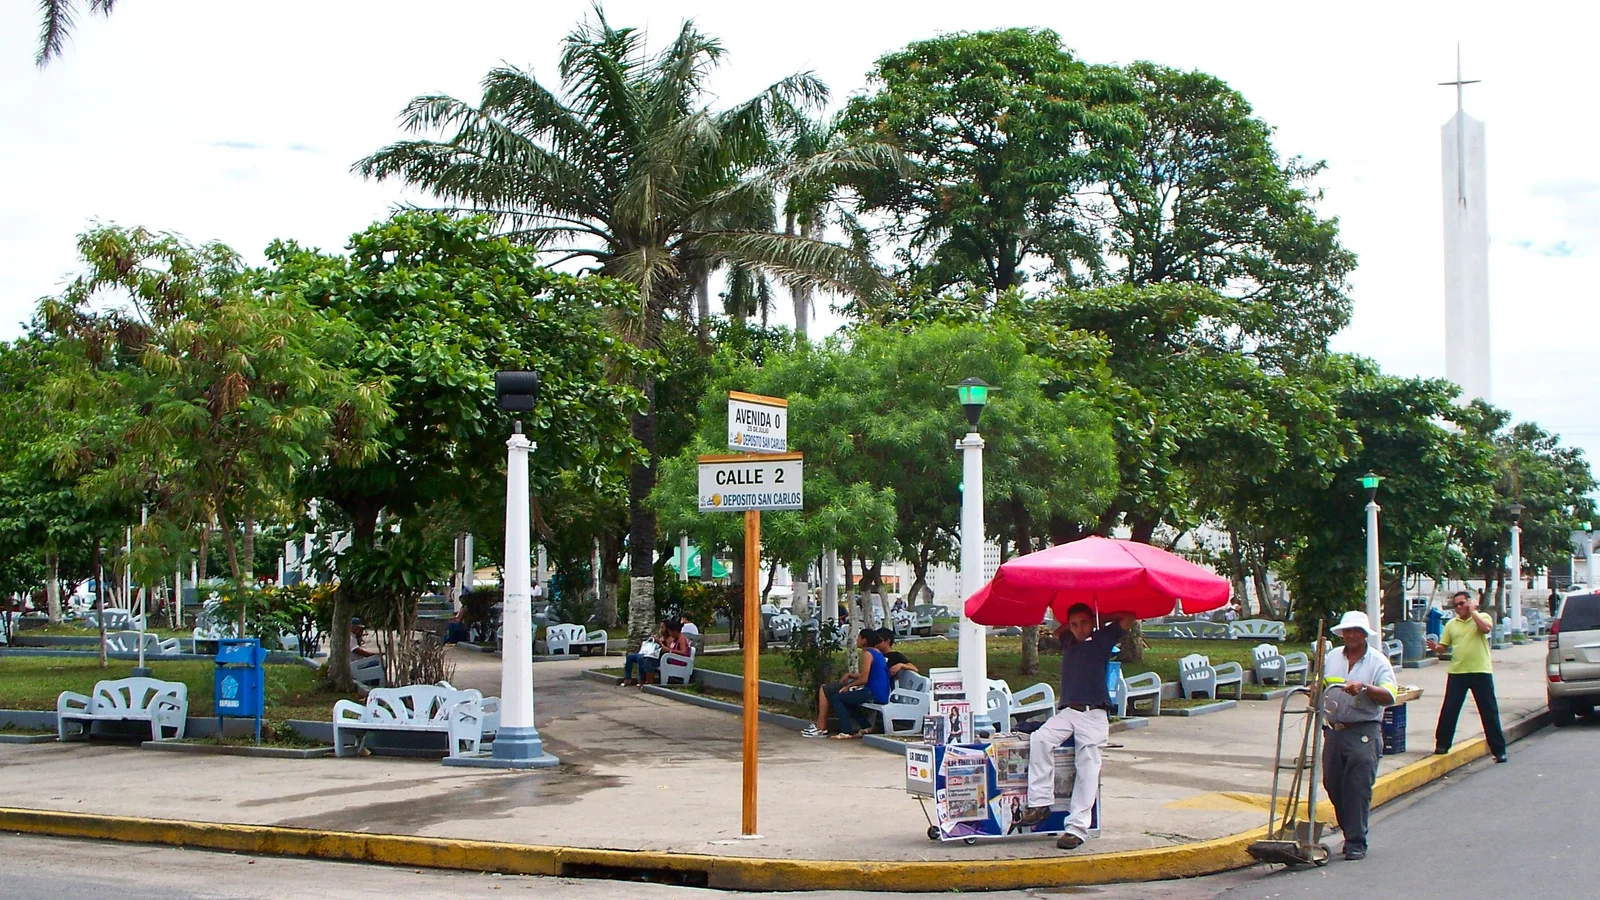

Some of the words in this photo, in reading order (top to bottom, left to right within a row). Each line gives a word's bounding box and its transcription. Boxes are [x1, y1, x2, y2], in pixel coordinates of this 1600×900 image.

[735, 408, 771, 428] AVENIDA
[775, 414, 780, 429] 0
[743, 434, 761, 447] DEPOSITO
[762, 436, 770, 448] SAN
[771, 438, 786, 450] CARLOS
[716, 469, 763, 485] CALLE
[774, 468, 784, 483] 2
[723, 493, 756, 506] DEPOSITO
[758, 493, 772, 505] SAN
[773, 492, 801, 505] CARLOS
